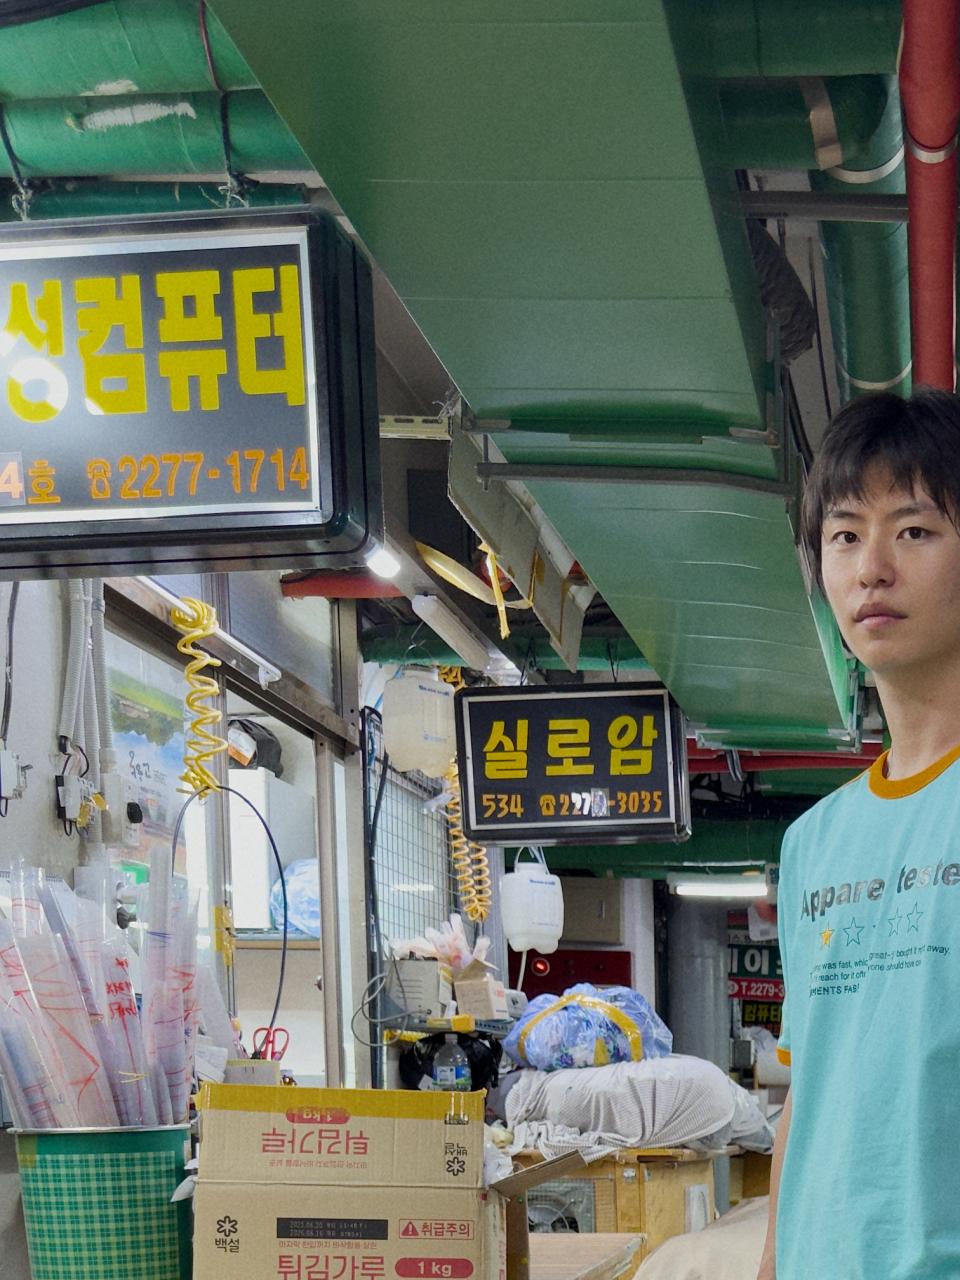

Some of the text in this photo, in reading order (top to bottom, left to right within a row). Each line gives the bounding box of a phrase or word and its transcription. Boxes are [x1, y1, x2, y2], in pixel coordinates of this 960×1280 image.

[118, 446, 310, 499] 2277-1714
[482, 715, 659, 780] 실로암
[482, 794, 525, 818] 534
[261, 1127, 370, 1156] 튀김가루
[420, 1222, 471, 1238] 취급주의
[214, 1236, 240, 1254] 백설
[417, 1262, 453, 1277] 1 kg
